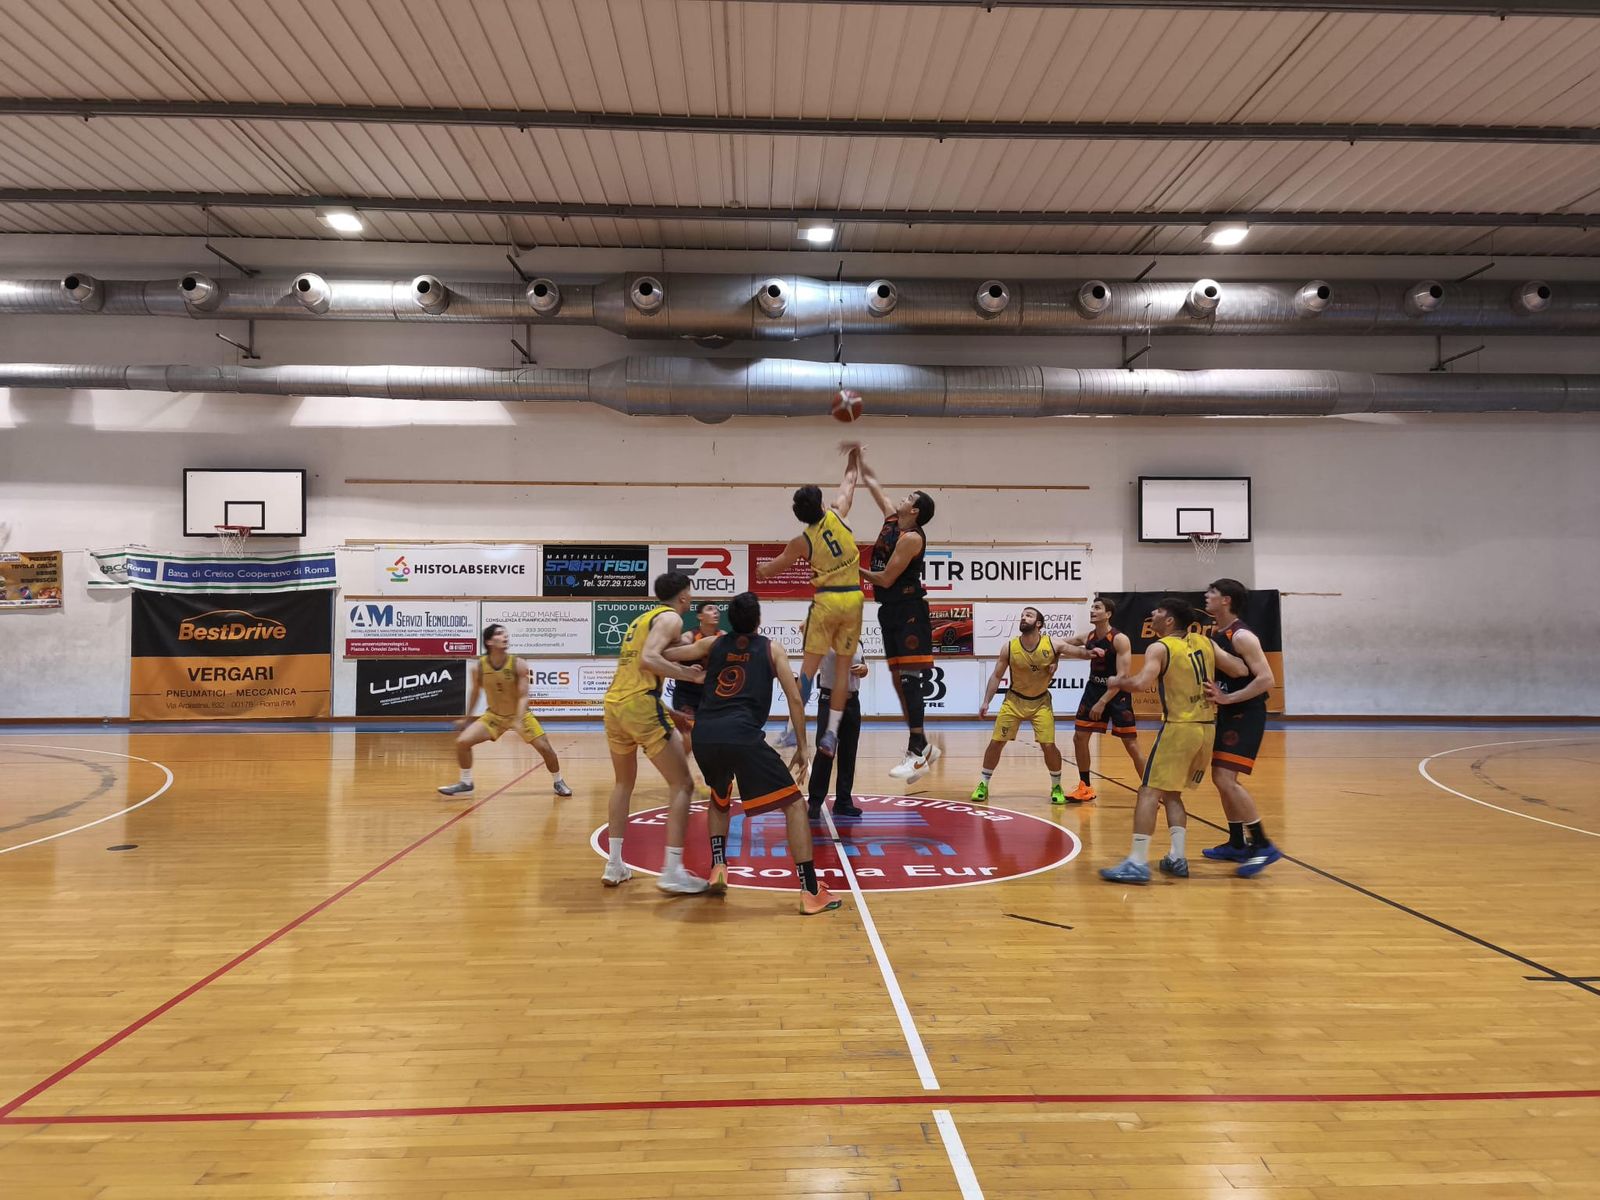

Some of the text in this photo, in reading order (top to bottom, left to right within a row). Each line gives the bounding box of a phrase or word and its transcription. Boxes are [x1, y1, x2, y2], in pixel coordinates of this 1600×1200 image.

[822, 529, 843, 557] 6
[127, 563, 151, 573] Roma
[237, 569, 291, 579] Cooperativo
[293, 567, 302, 575] di
[304, 566, 330, 574] Roma
[414, 564, 525, 575] HISTOLABSERVICE
[971, 561, 1082, 581] BONIFICHE
[597, 604, 627, 612] STUDIO
[350, 604, 394, 628] AM
[178, 622, 287, 641] BestDrive
[187, 666, 274, 682] VERGARI
[370, 669, 453, 694] LUDMA
[715, 665, 746, 697] 9
[1048, 678, 1084, 689] ZILLI
[166, 687, 297, 698] PNEUMATICI MECCANICA
[725, 864, 999, 878] Roma Eur
